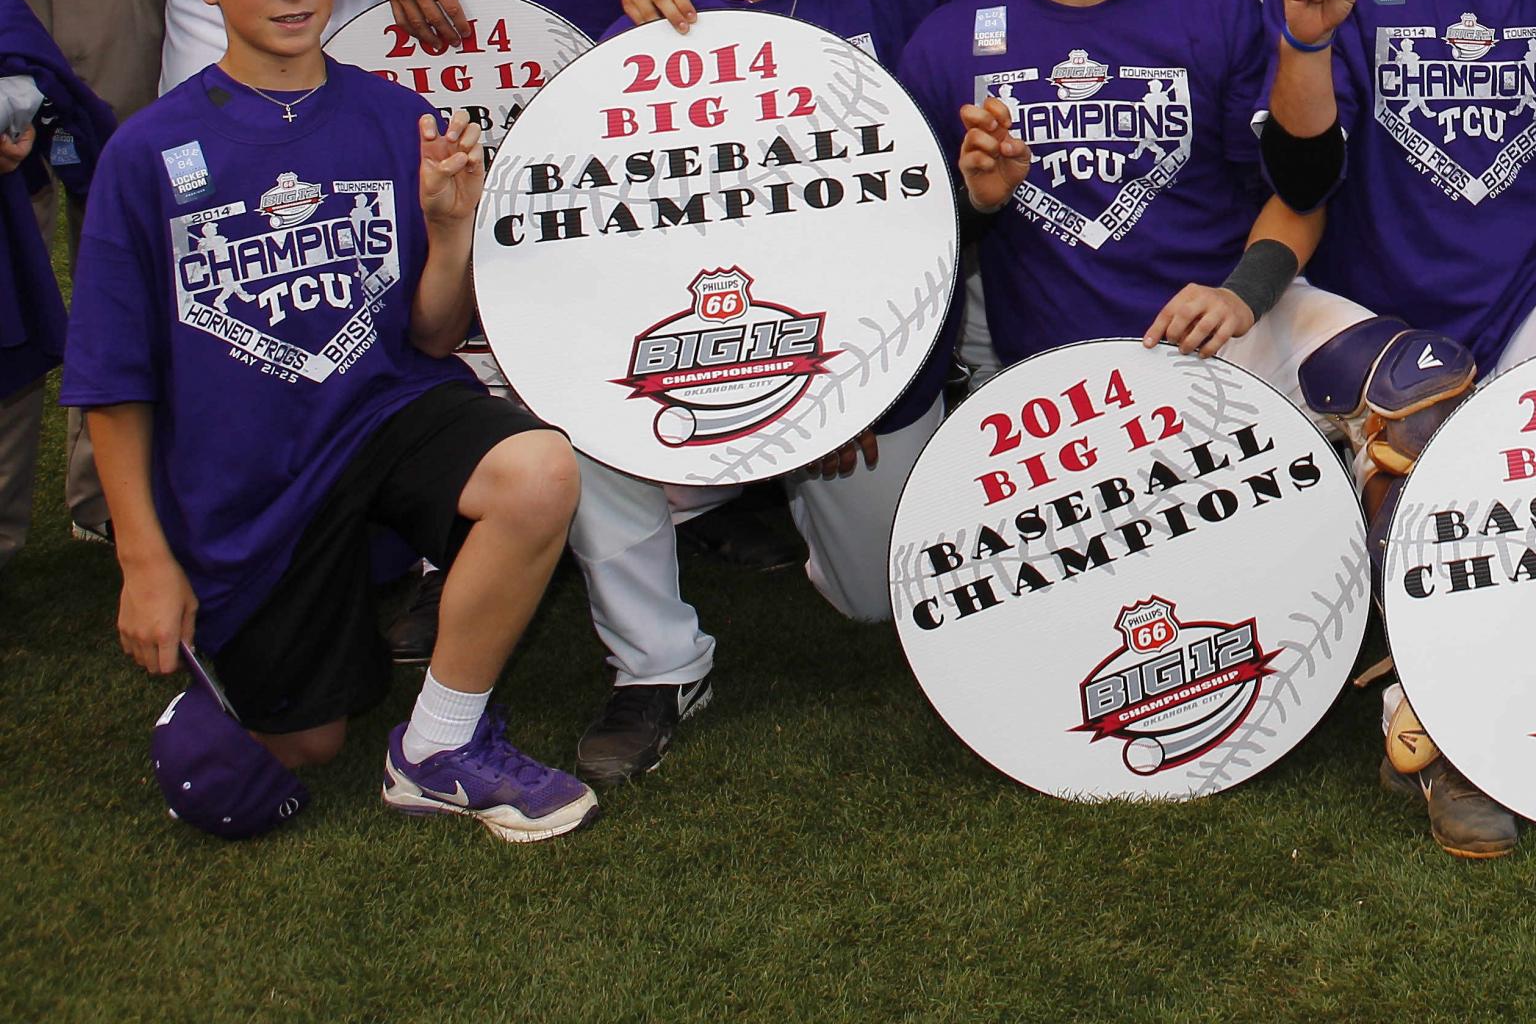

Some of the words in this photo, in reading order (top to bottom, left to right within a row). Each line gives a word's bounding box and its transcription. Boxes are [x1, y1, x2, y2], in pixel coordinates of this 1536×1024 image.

[495, 60, 546, 90] 12
[622, 41, 778, 94] 2014
[600, 95, 729, 139] BIG
[755, 86, 817, 121] 12
[1017, 103, 1189, 143] HAMPIONS
[1437, 106, 1505, 144] TCU
[171, 167, 208, 191] LOCKER
[525, 124, 895, 195] BASEBALL
[1042, 147, 1126, 187] TCU
[178, 178, 207, 195] ROOM
[493, 164, 931, 247] CHAMPIONS
[179, 218, 394, 293] CHAMPIONS
[258, 273, 353, 326] TCU
[701, 279, 739, 293] PHILLIPS
[705, 294, 738, 316] 66
[634, 324, 747, 376] BIG
[748, 318, 820, 362] 12
[661, 360, 795, 386] CHAMPIONSHIP
[683, 380, 745, 397] OKLAHOMA
[747, 378, 774, 391] CITY
[979, 368, 1137, 457] 2014
[973, 436, 1099, 506] BIG
[1120, 405, 1185, 453] 12
[920, 423, 1275, 578] BASEBALL
[911, 452, 1322, 631] CHAMPIONS
[1127, 607, 1163, 630] PHILLIPS
[1135, 621, 1168, 647] 66
[1087, 655, 1186, 719] BIG
[1187, 625, 1254, 676] 12
[1118, 669, 1240, 723] CHAMPIONSHIP
[1142, 701, 1200, 728] OKLAHOMA
[1201, 691, 1225, 708] CITY
